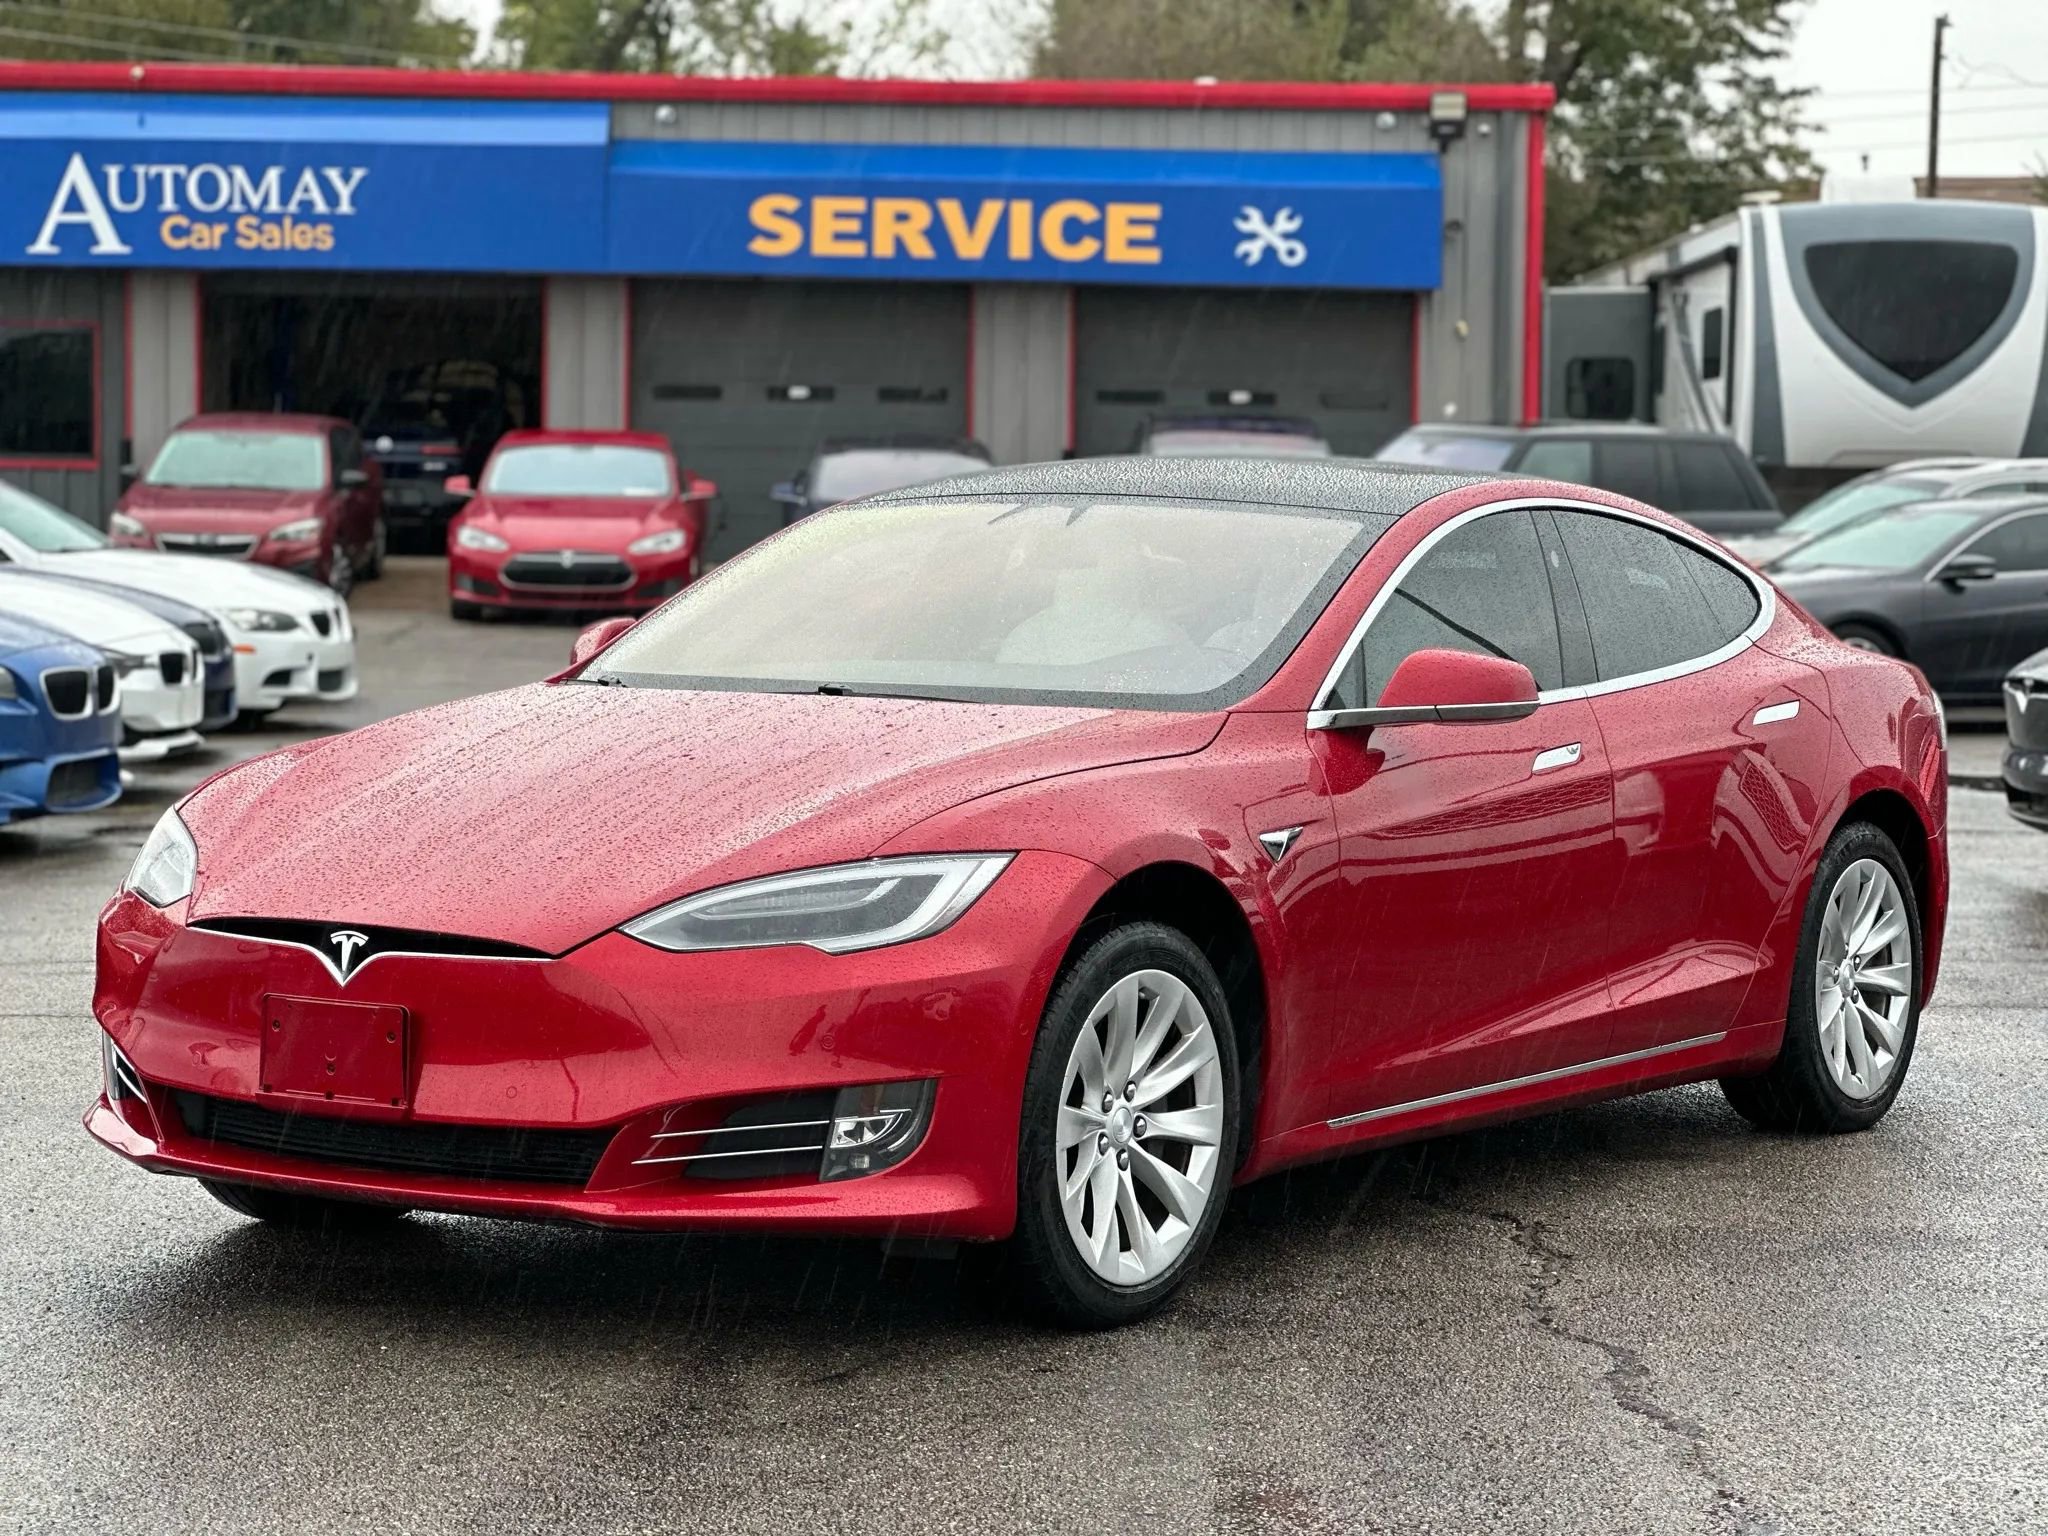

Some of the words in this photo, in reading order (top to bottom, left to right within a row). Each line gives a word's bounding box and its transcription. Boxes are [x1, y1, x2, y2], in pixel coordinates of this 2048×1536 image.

[26, 153, 368, 255] AUTOMAY
[160, 214, 229, 250] Car
[235, 214, 335, 251] Sales
[748, 193, 1162, 264] SERVICE
